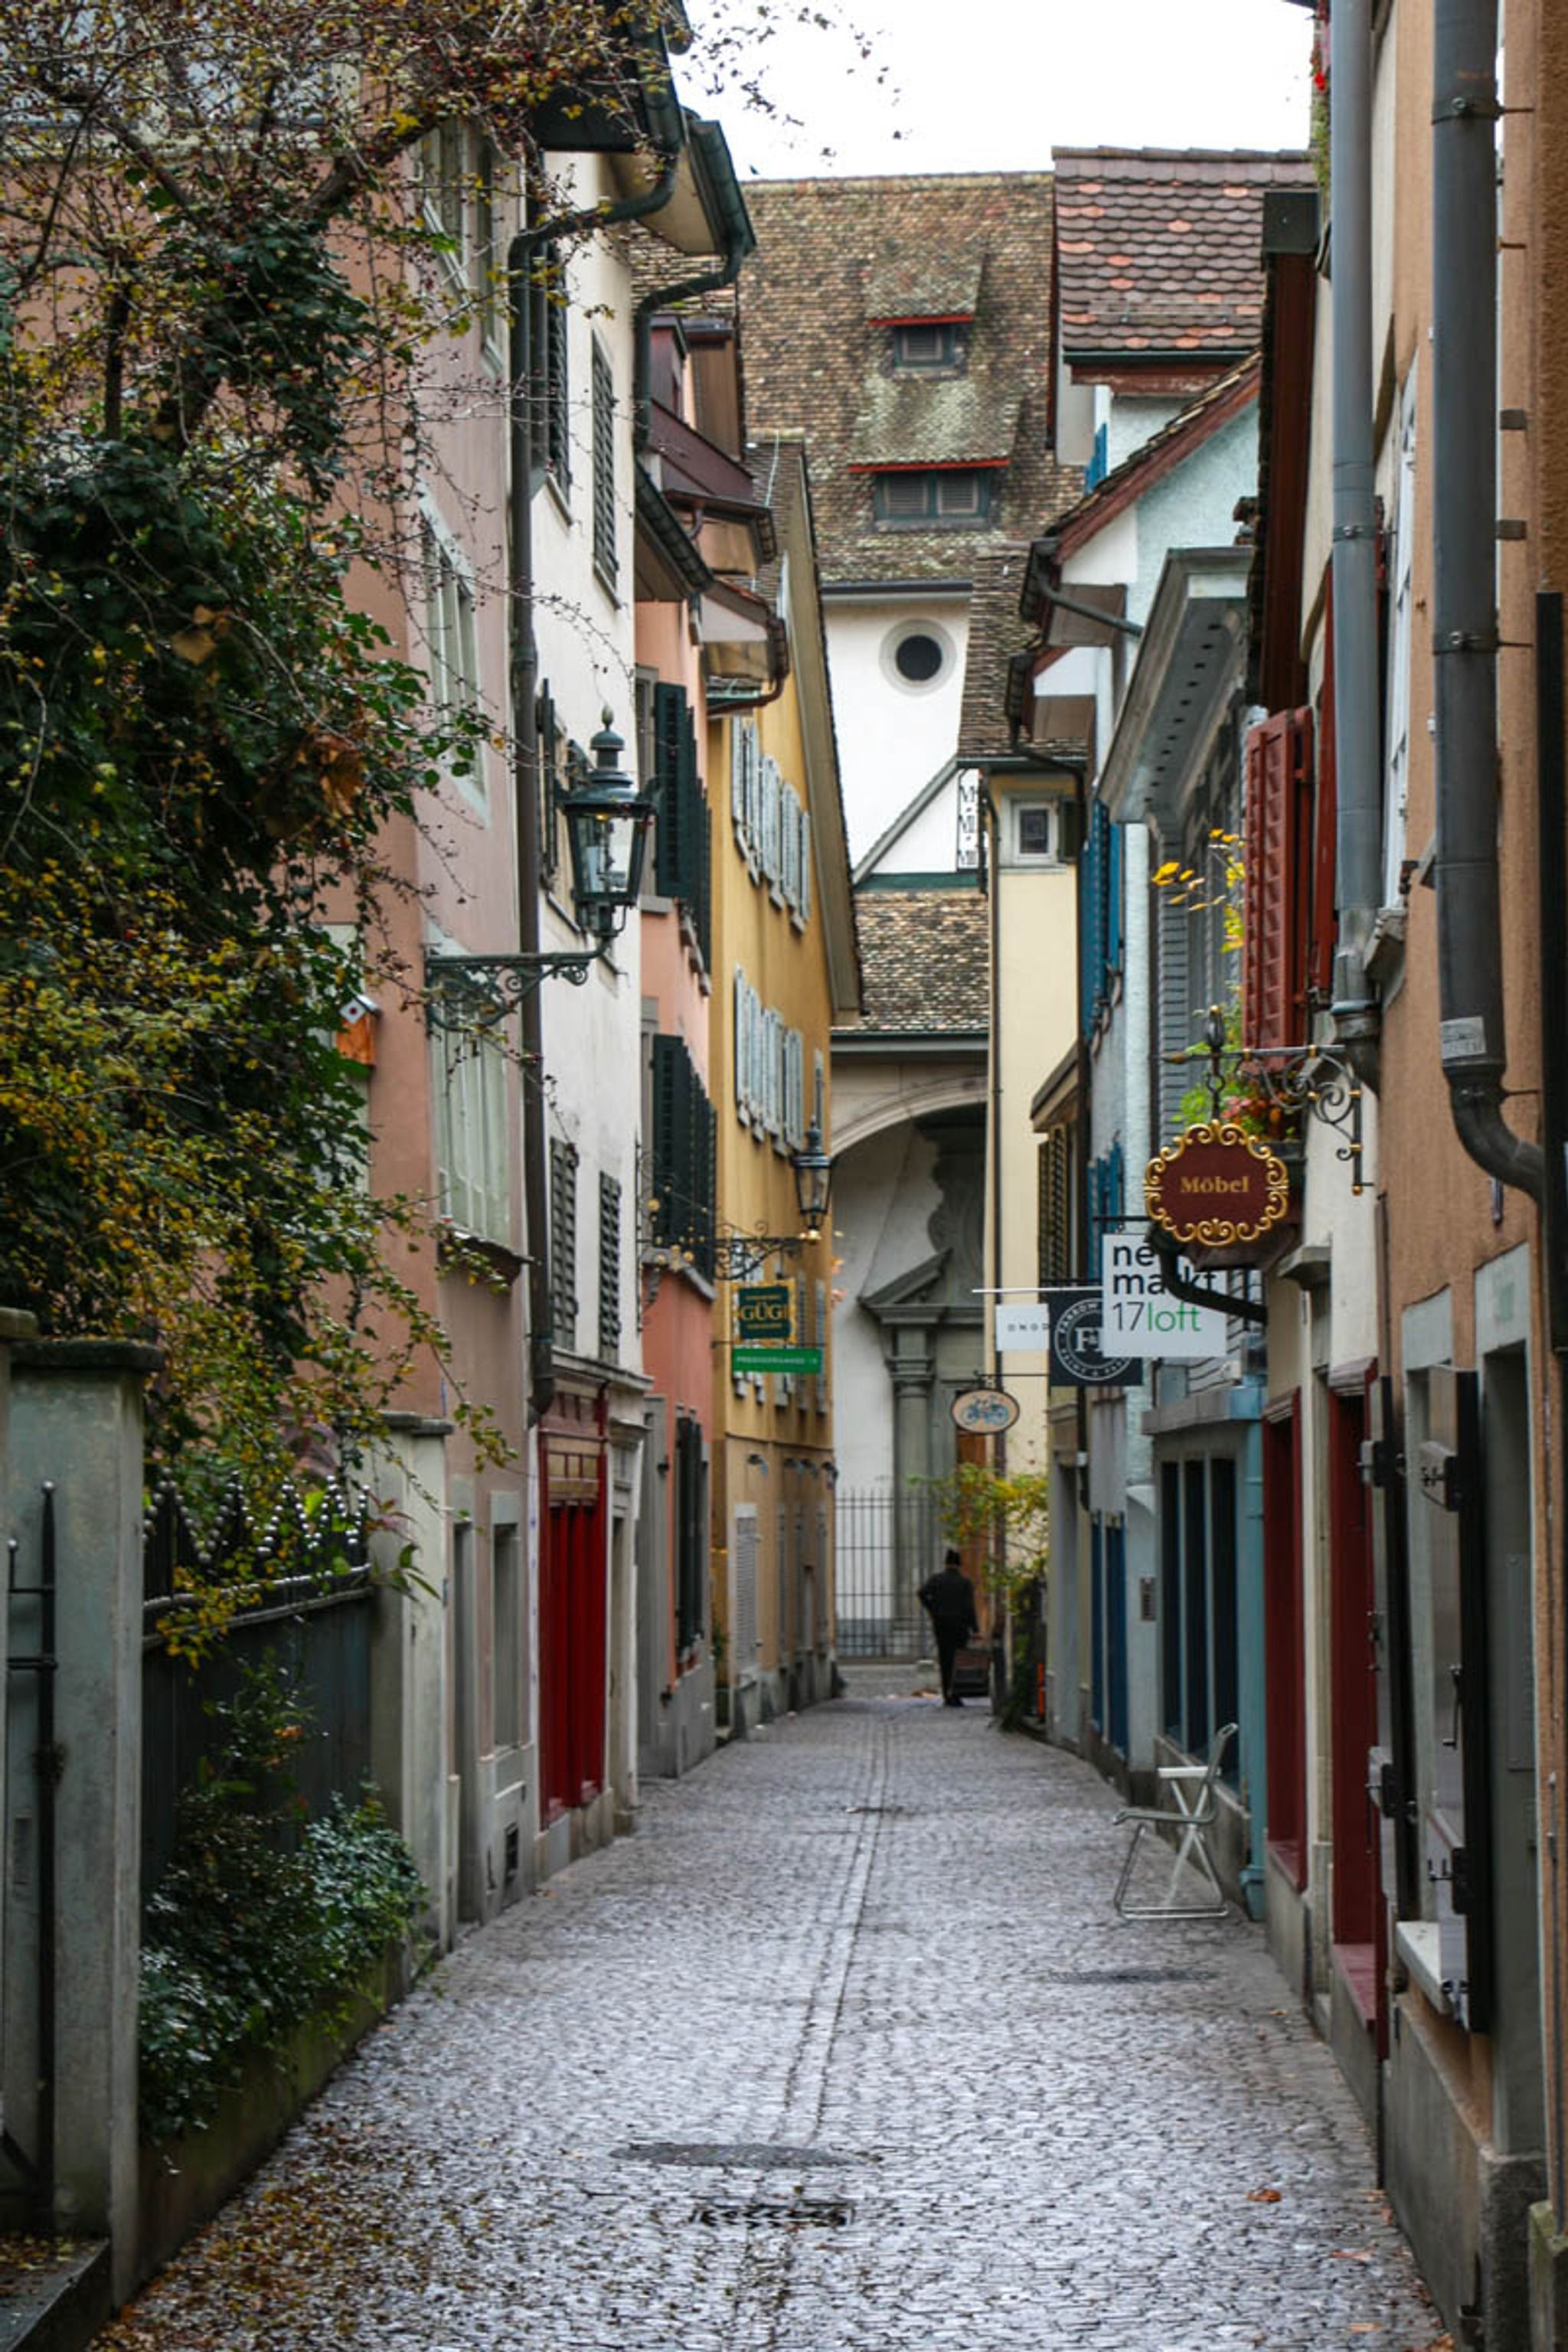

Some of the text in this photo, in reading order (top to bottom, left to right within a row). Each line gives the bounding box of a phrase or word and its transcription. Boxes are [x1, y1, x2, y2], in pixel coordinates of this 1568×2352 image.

[1180, 1175, 1250, 1193] Möbel
[1112, 1245, 1155, 1267] ne
[1112, 1266, 1217, 1295] makt
